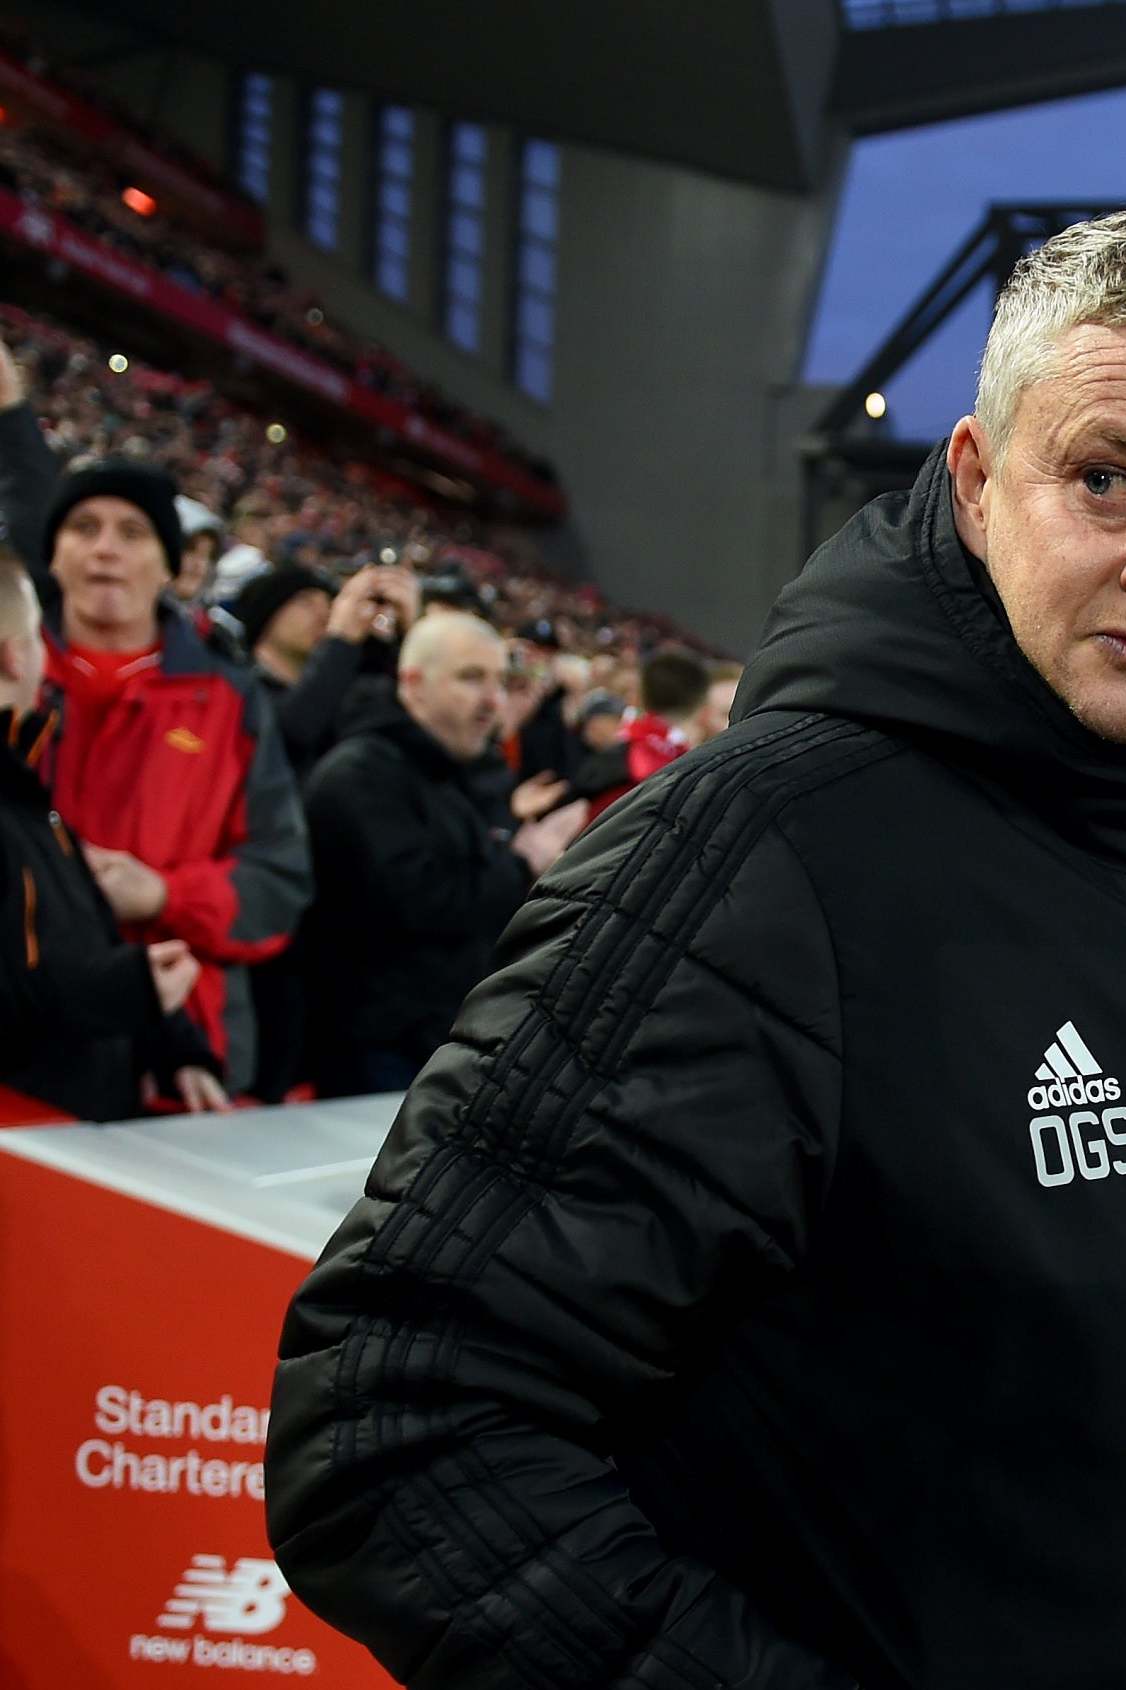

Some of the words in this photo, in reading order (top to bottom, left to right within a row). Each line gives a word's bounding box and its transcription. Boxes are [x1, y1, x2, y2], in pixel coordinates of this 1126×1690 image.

[1027, 1074, 1121, 1110] adidas
[129, 1634, 191, 1663] new
[193, 1635, 316, 1675] balance
